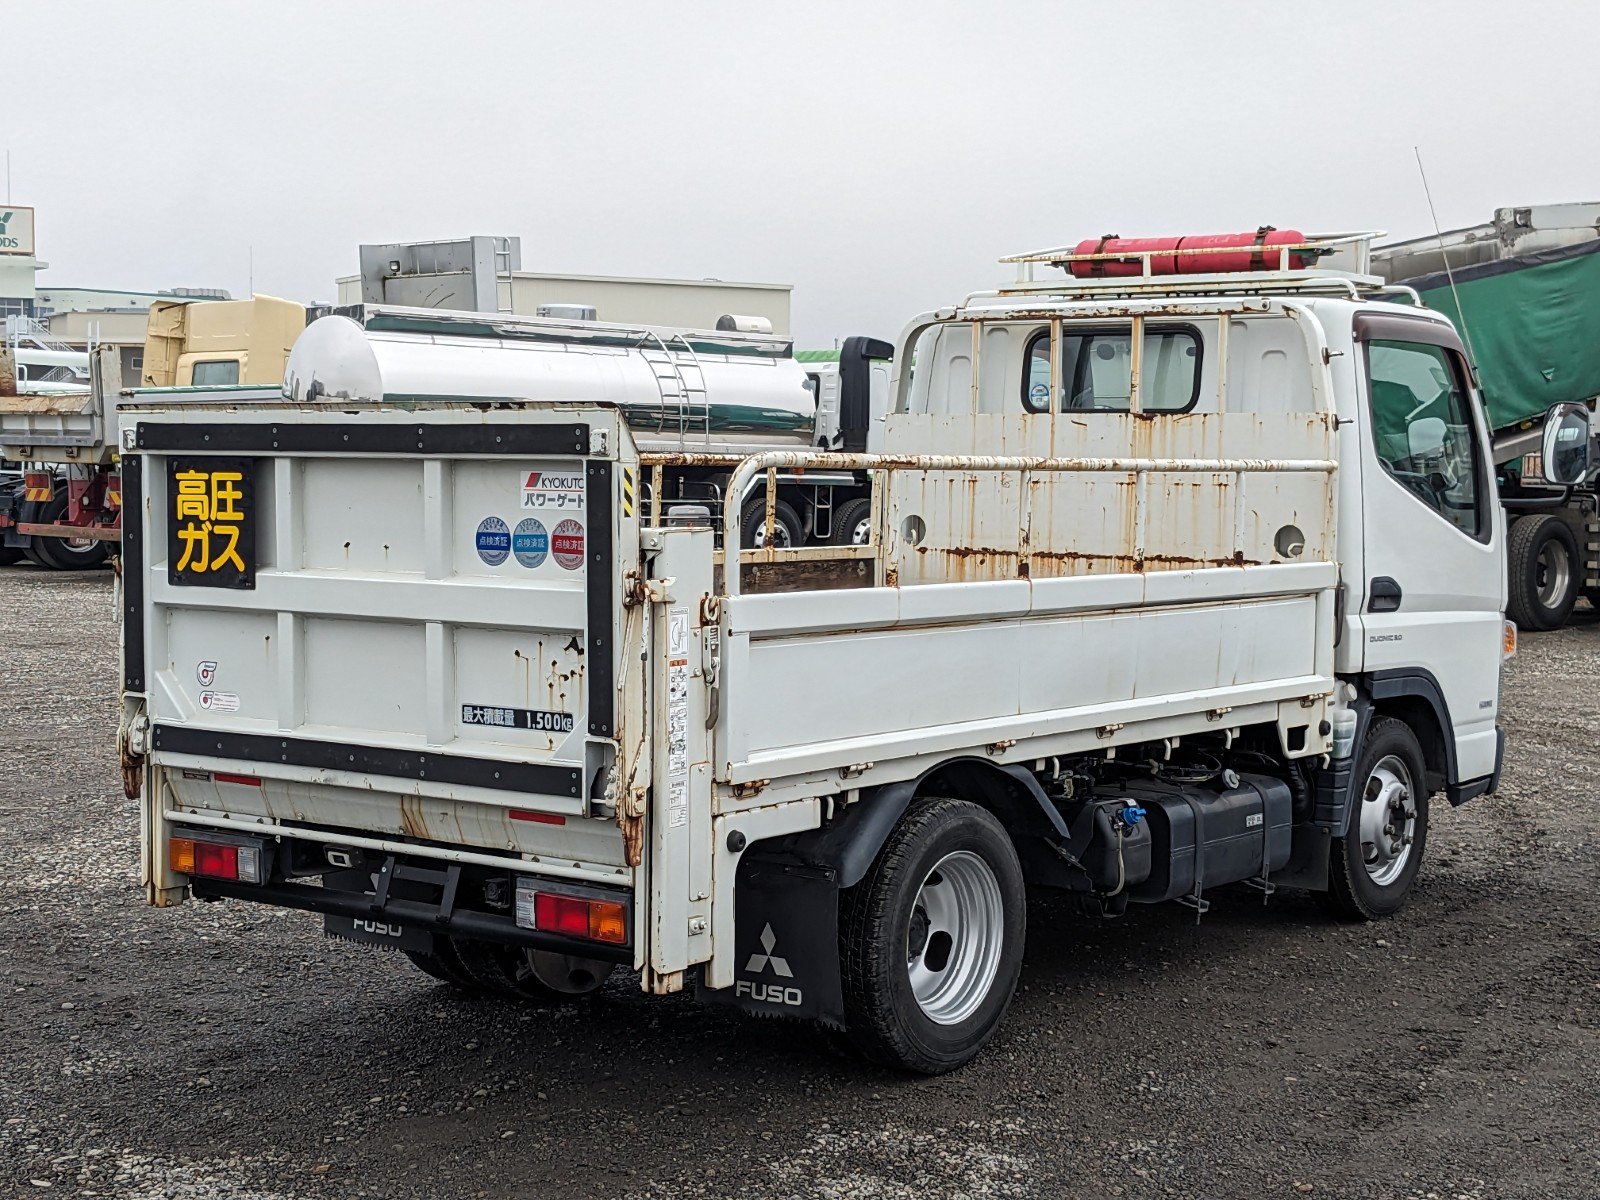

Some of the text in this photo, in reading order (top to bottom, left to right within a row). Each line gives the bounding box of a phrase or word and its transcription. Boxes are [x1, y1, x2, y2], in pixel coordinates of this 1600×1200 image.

[175, 469, 245, 521] 高圧
[524, 493, 584, 509] パワーゲート
[176, 520, 245, 573] ガス
[479, 536, 508, 547] 点検済証
[516, 538, 545, 548] 点検済証
[463, 706, 515, 727] 最大積載量
[736, 980, 802, 1006] FUSO
